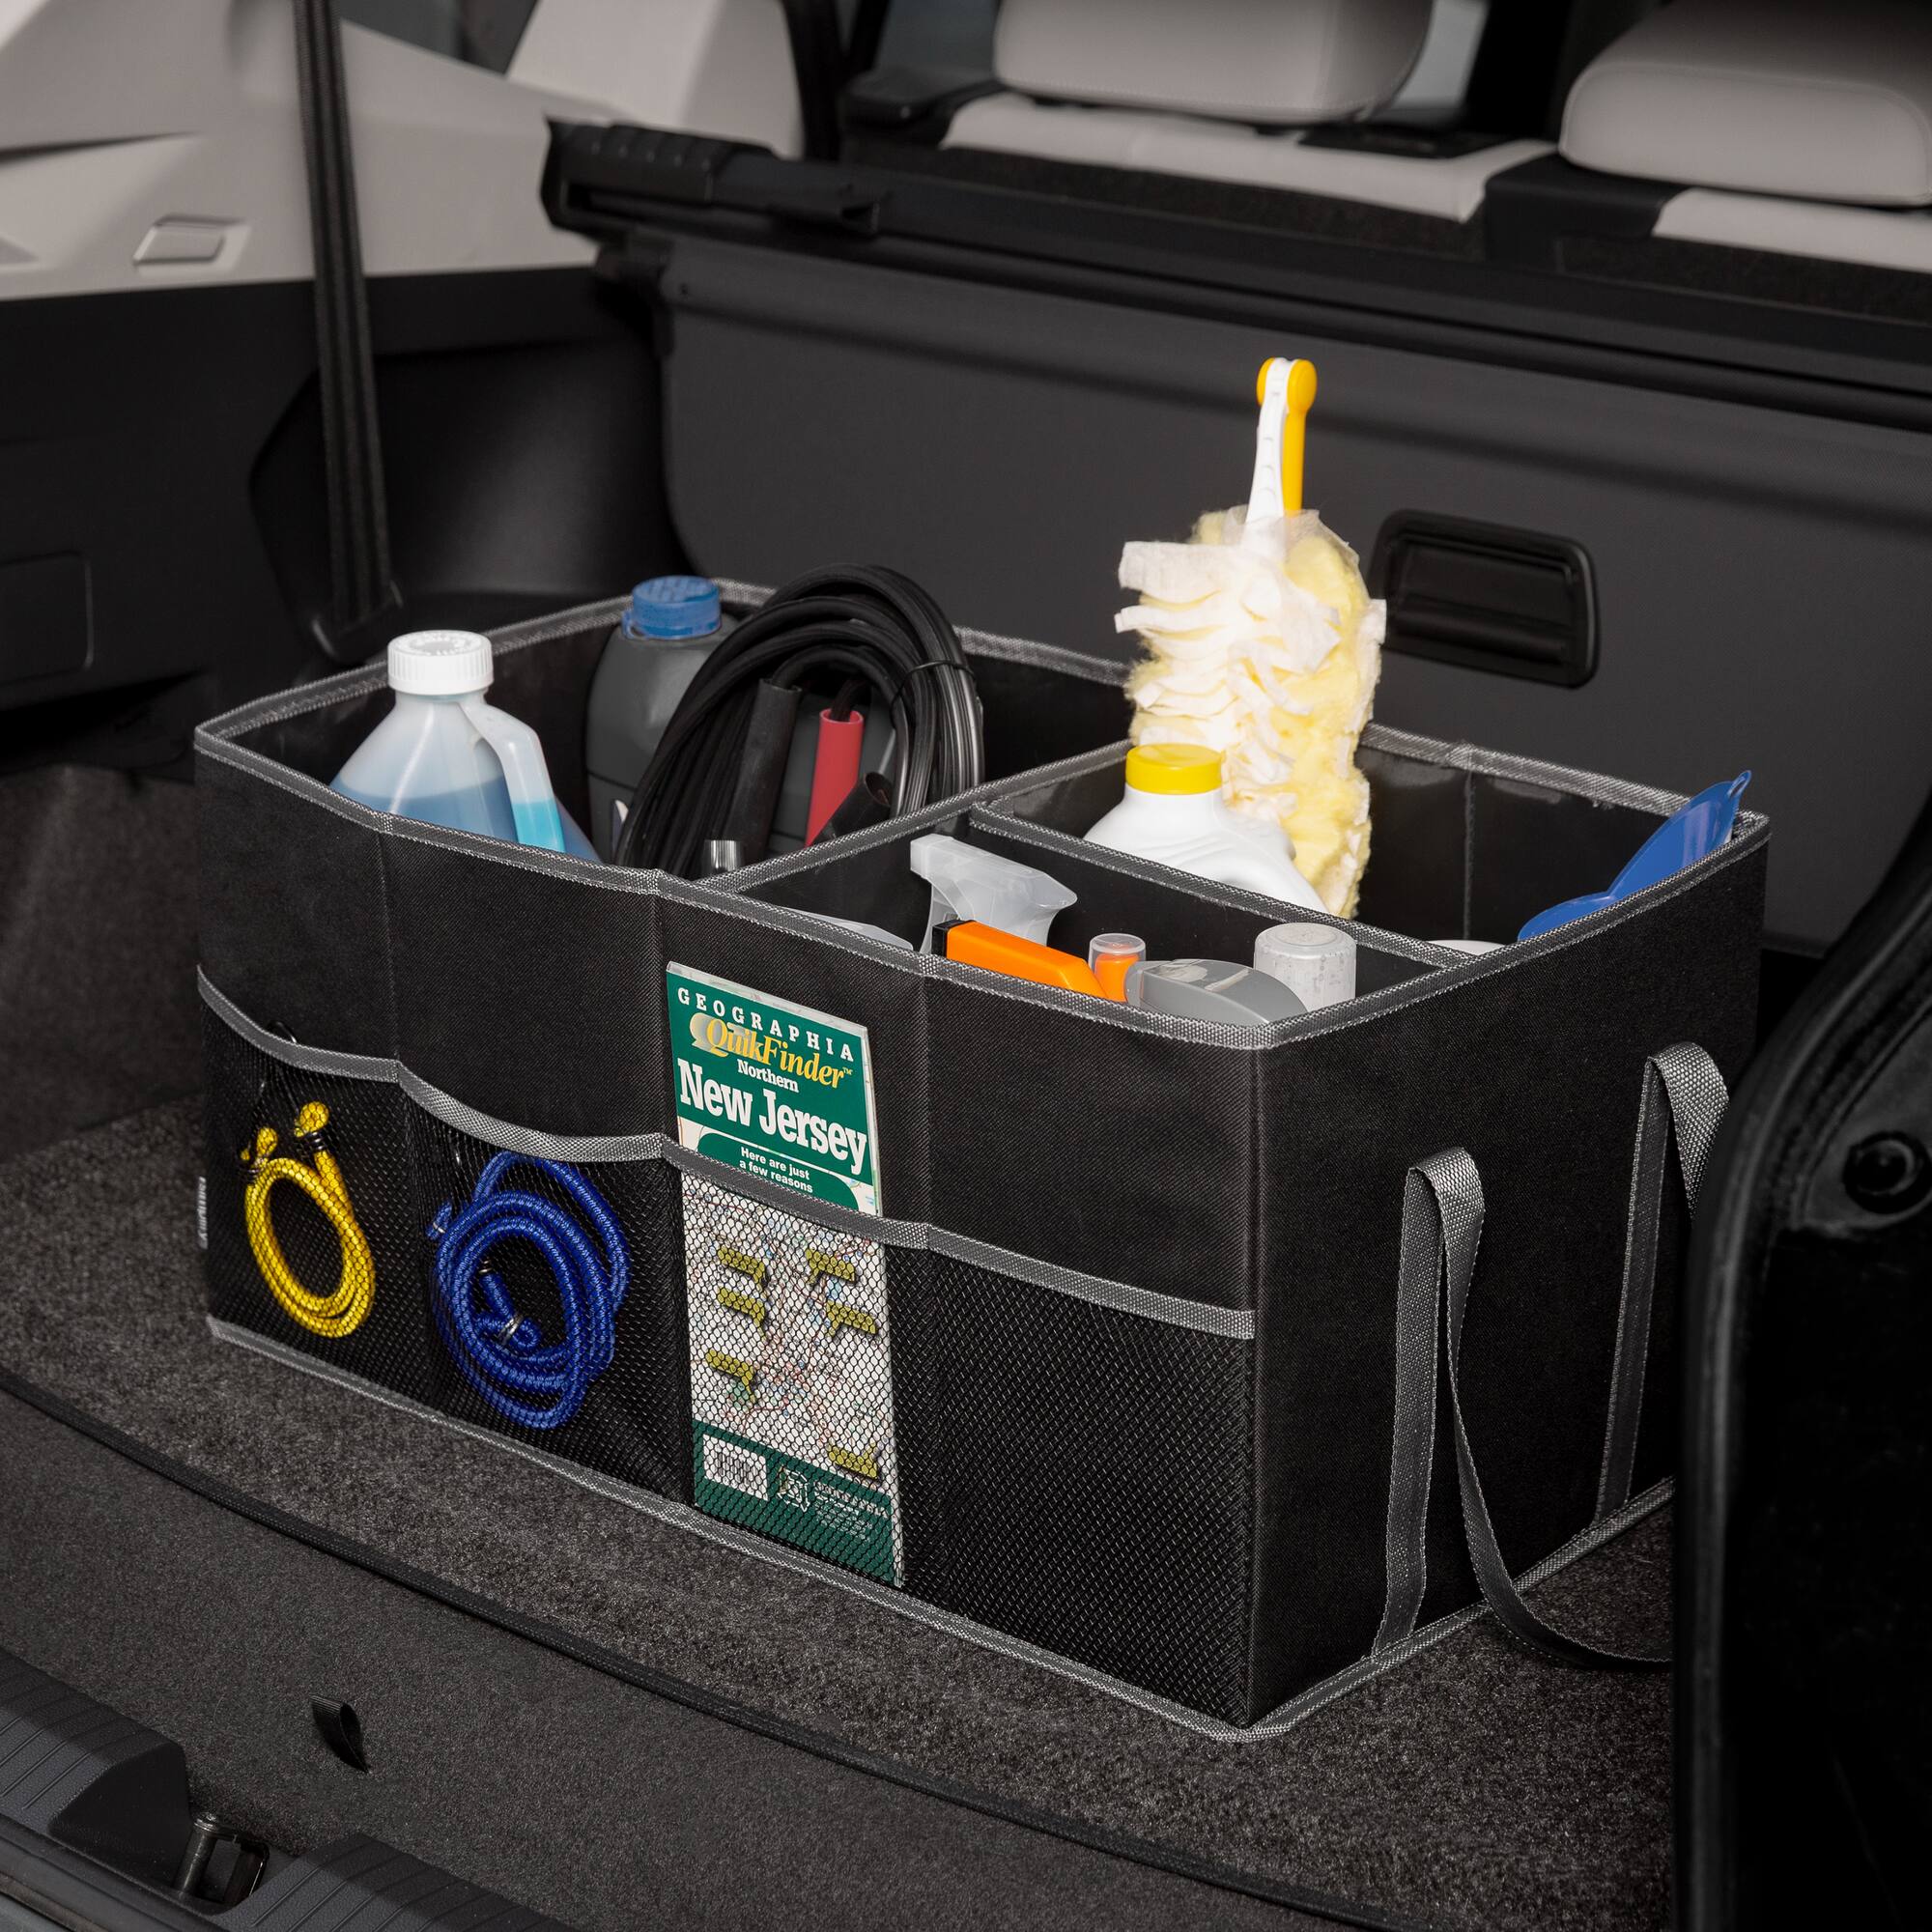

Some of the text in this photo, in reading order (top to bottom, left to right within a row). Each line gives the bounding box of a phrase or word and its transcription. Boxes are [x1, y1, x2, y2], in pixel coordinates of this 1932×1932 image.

[678, 987, 854, 1062] GEOGRAPHIA
[737, 1059, 799, 1093] Northern
[677, 1058, 867, 1176] New Jersey
[739, 1159, 813, 1193] a few reasons
[741, 1147, 810, 1180] Here are just
